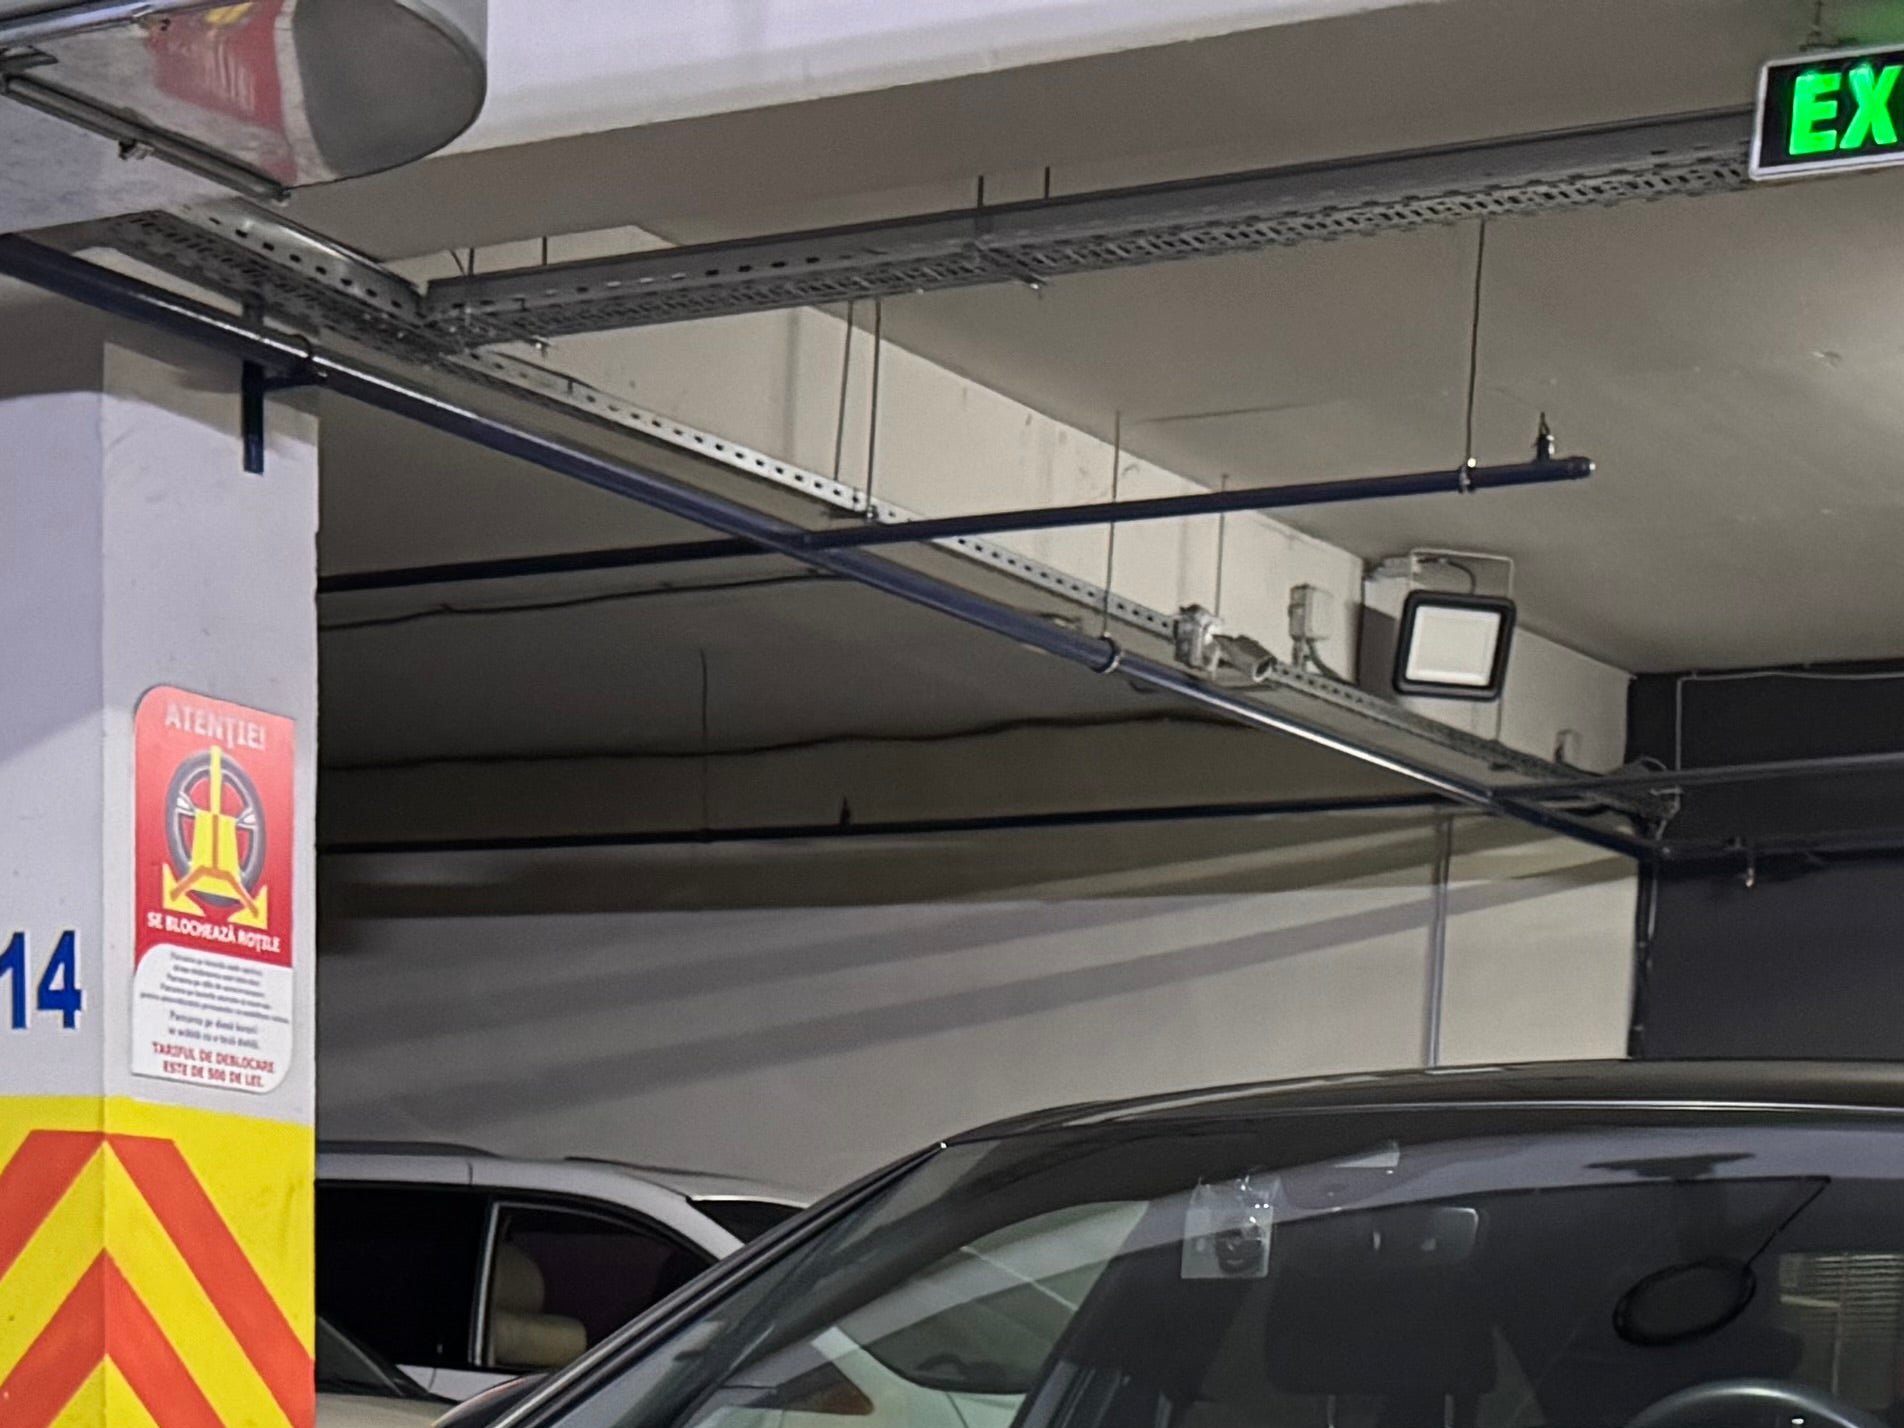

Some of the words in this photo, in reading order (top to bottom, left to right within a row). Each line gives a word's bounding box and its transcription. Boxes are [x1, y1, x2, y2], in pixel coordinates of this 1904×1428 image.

[147, 911, 163, 929] SE
[163, 1060, 188, 1076] ESTE
[191, 1064, 204, 1079] DE
[229, 1071, 242, 1085] DE
[199, 1049, 213, 1064] DE
[216, 1052, 275, 1073] DEBLOCARE
